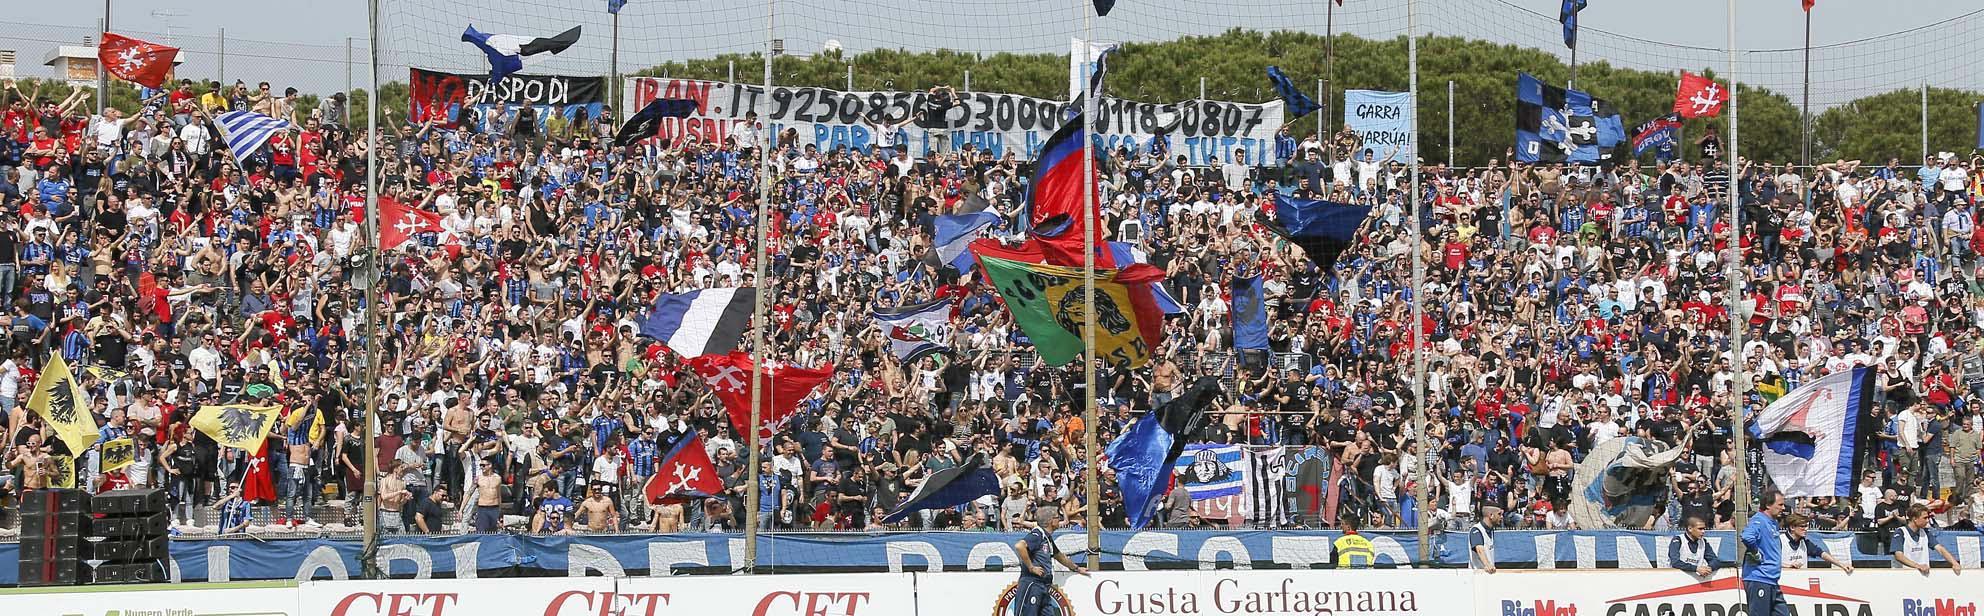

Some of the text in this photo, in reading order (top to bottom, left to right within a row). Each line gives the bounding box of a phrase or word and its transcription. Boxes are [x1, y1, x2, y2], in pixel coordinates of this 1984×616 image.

[467, 77, 544, 104] DASPO
[549, 76, 569, 104] DI
[1357, 104, 1400, 119] GARRA
[1184, 136, 1267, 166] TUTTI
[1095, 577, 1418, 616] Gusta Garfagnana
